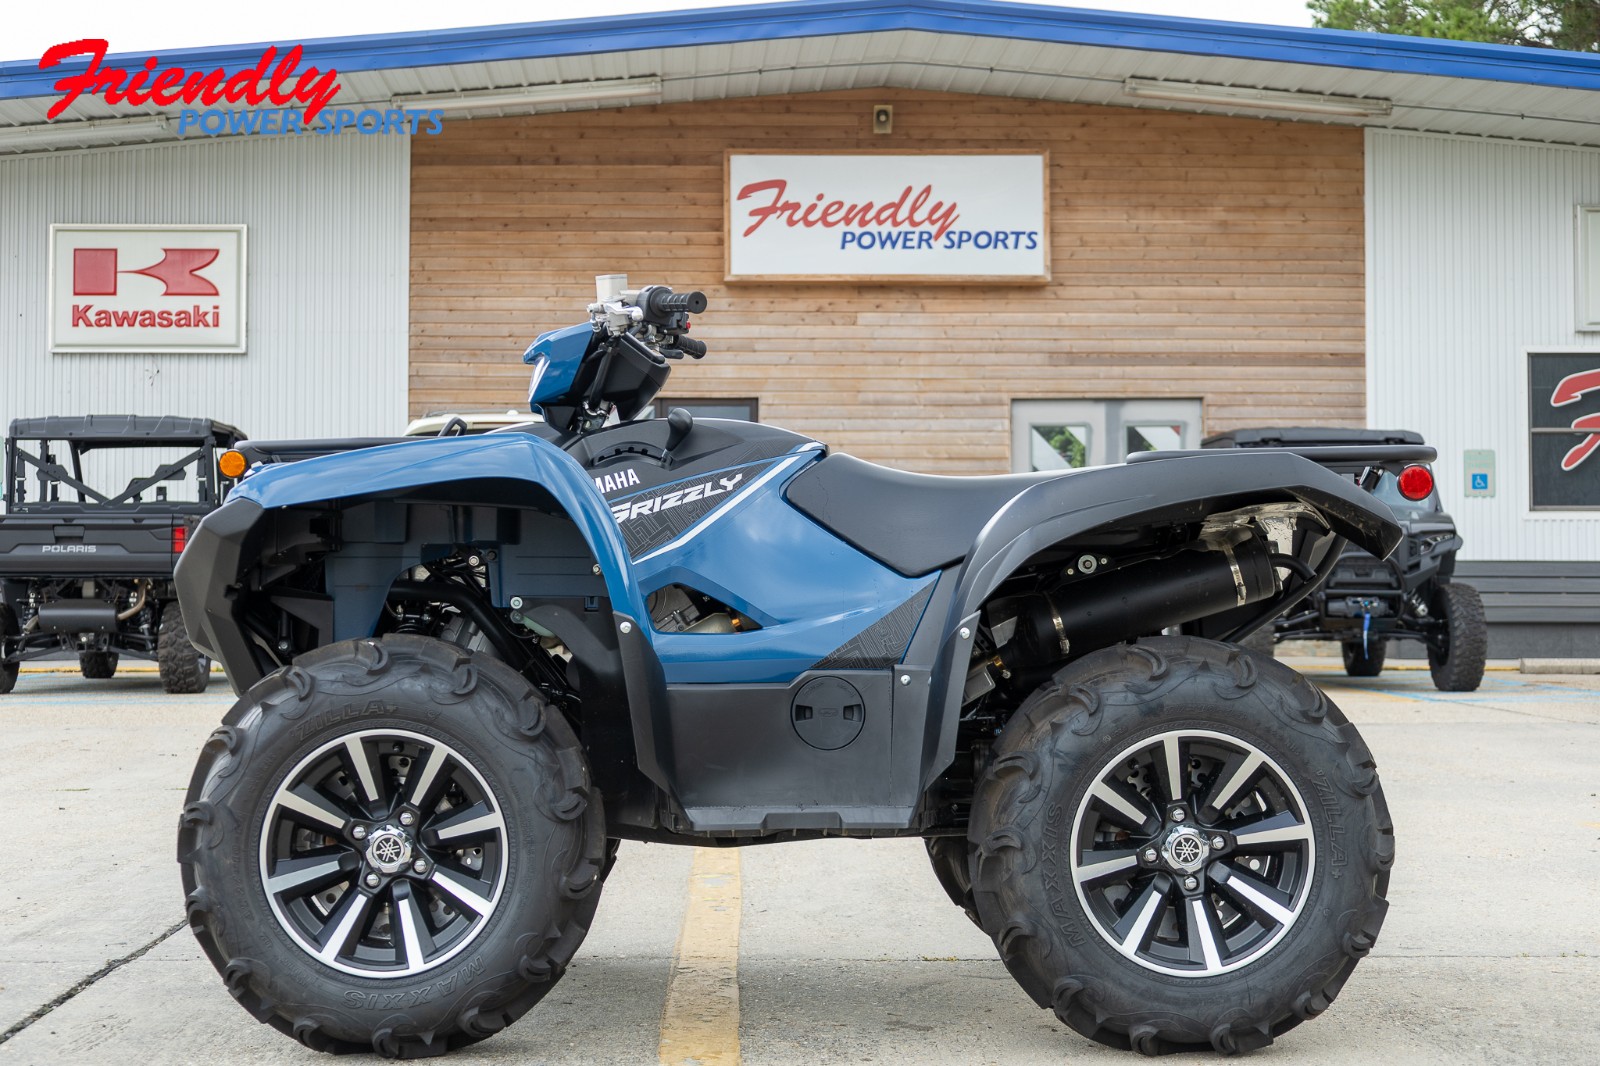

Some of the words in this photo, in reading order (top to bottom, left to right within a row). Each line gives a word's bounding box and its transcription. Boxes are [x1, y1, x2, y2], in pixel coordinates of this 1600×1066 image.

[737, 179, 960, 241] Friendly
[840, 231, 934, 250] POWER
[944, 231, 1038, 250] SPORTS
[72, 305, 220, 328] Kawasaki
[592, 468, 640, 494] MAHA
[42, 545, 97, 553] POLARIS
[1041, 801, 1087, 948] MAXXIS
[341, 955, 487, 1011] MAXXIS
